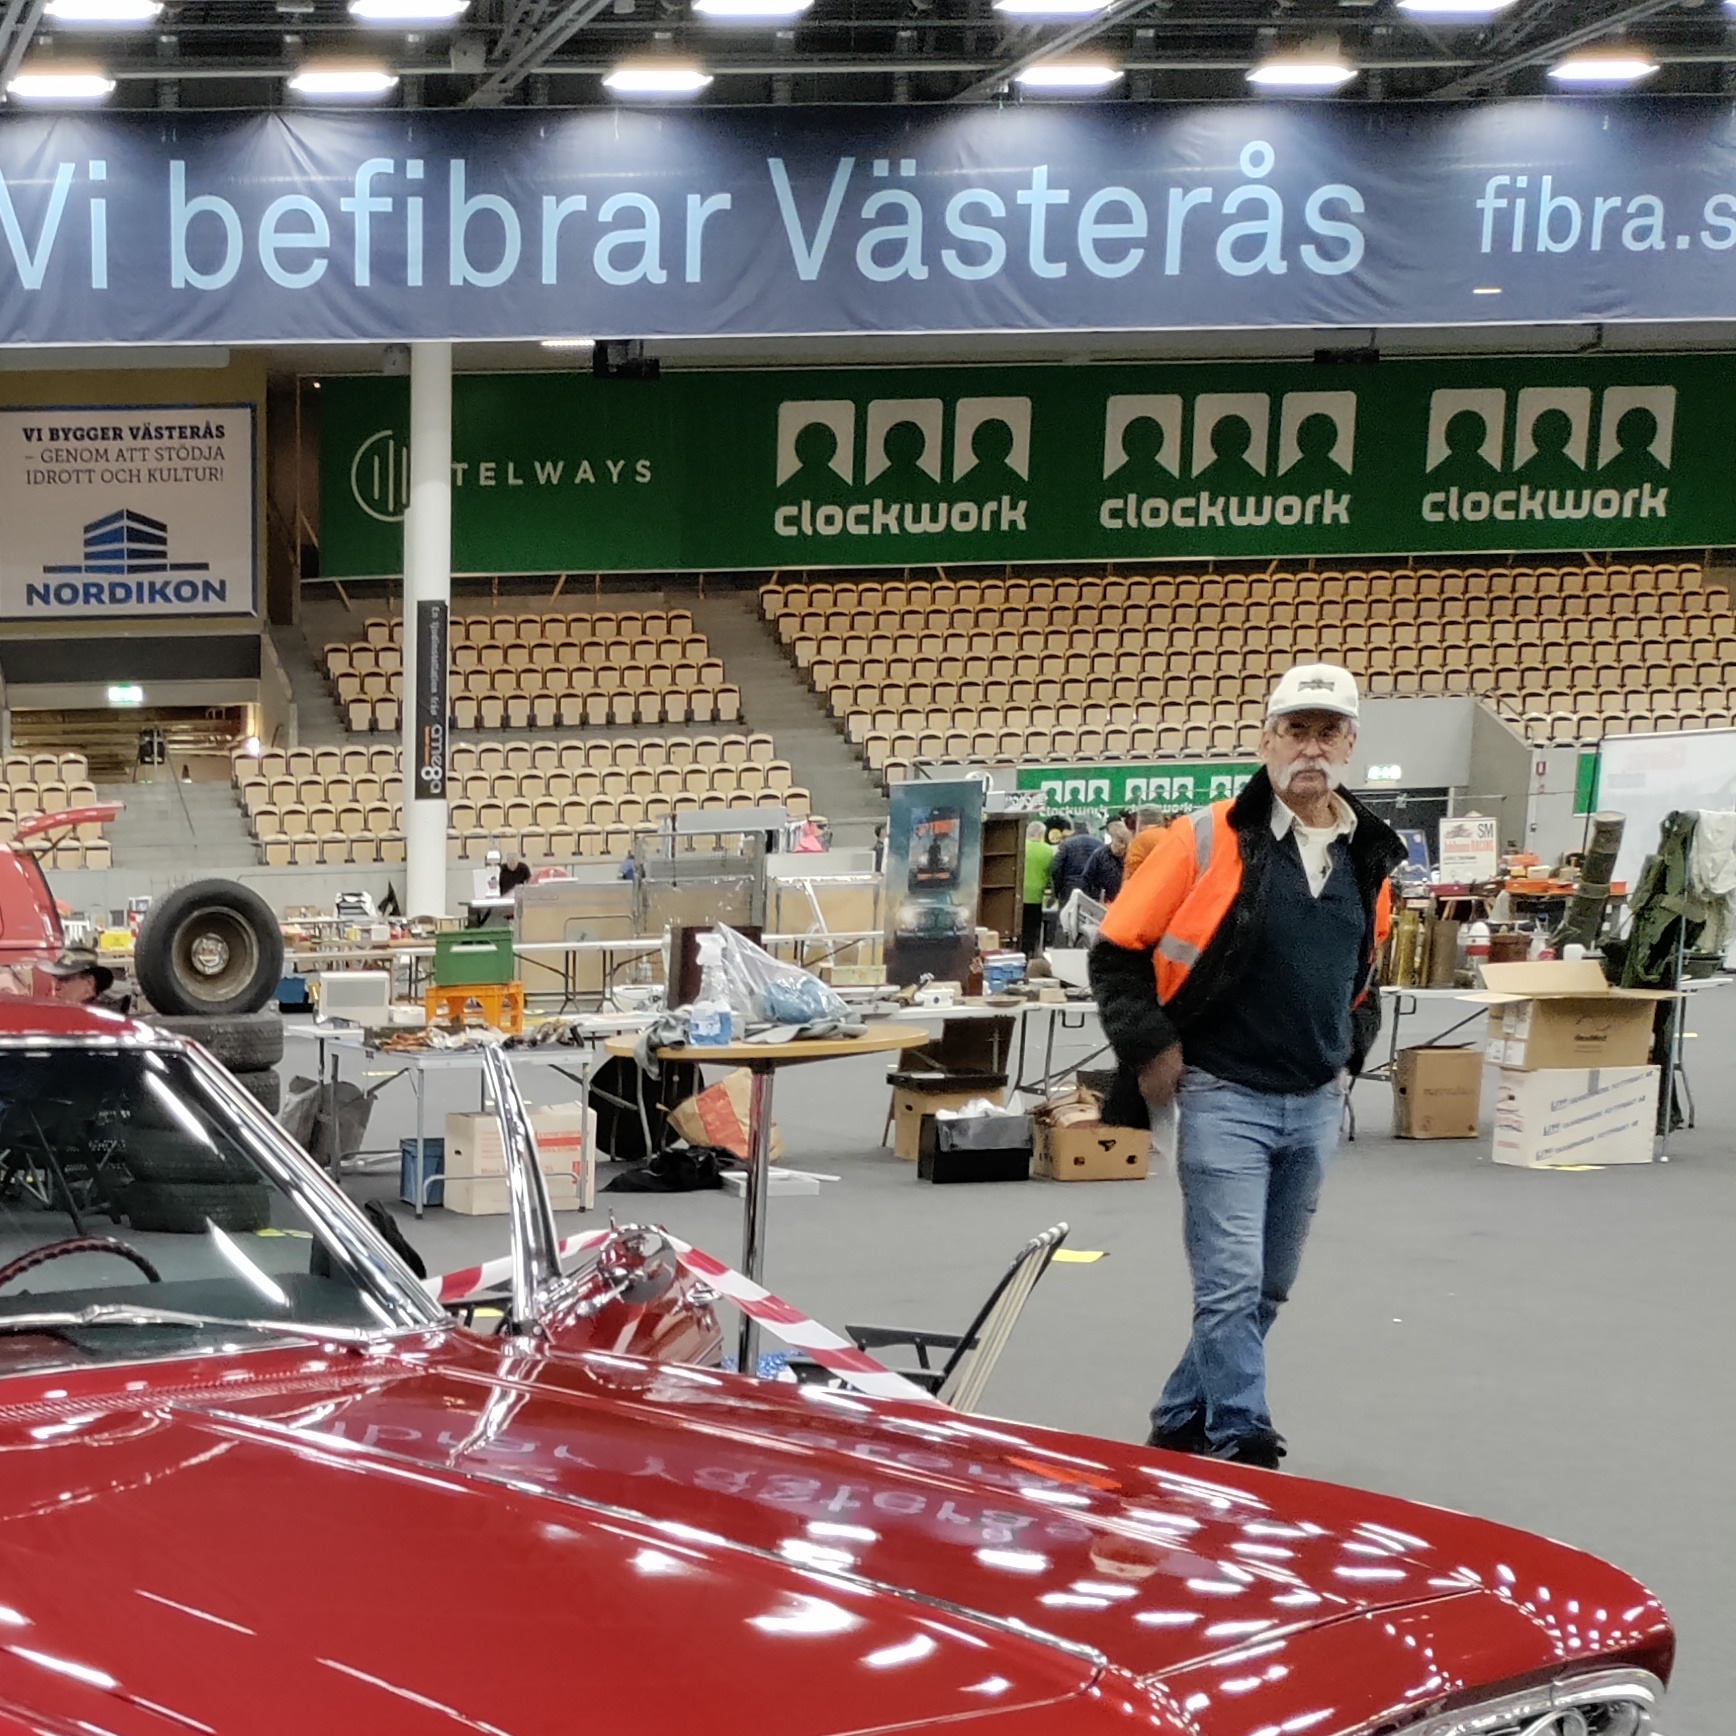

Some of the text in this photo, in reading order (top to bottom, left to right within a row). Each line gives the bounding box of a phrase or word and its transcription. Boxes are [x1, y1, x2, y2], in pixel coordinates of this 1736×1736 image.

[169, 157, 731, 290] befibrar
[768, 140, 1365, 281] Västerås
[22, 421, 225, 442] VI BYGGER VÄSTERÅS
[40, 447, 109, 463] GENOM
[115, 447, 147, 461] ATT
[154, 443, 225, 461] STÖDJA
[26, 467, 224, 485] IDROTT OCH KULTUR!
[451, 460, 652, 486] TELWAYS
[774, 495, 1027, 537] clockwork
[1099, 489, 1351, 530] clockwork
[1421, 483, 1668, 523] clockwork
[26, 579, 226, 606] NORDIKON
